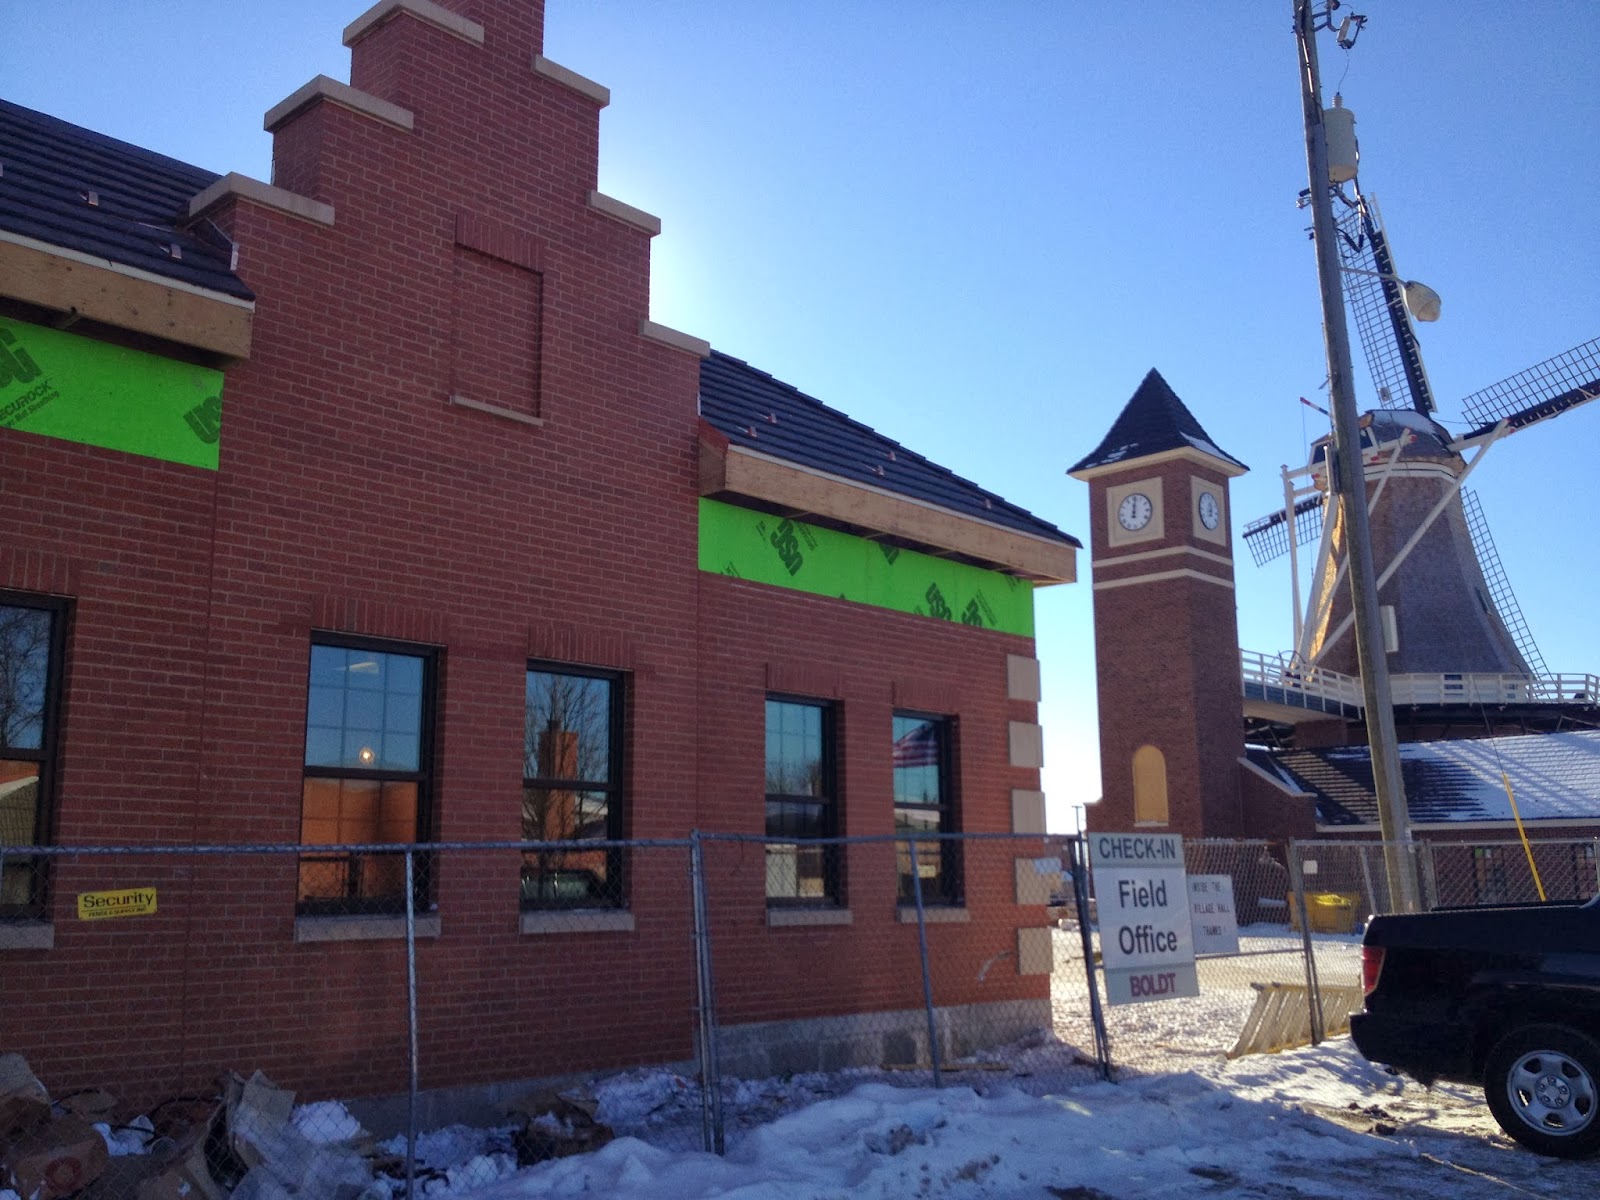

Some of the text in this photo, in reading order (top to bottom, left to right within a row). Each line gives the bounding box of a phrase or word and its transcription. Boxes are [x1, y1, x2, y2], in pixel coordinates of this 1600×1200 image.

[1099, 837, 1176, 859] CHECK-IN
[84, 892, 154, 908] Security
[1118, 880, 1168, 907] Field
[1194, 902, 1230, 914] VILLAGE HALL
[1119, 925, 1177, 954] Office
[1129, 973, 1176, 998] BOLDT
